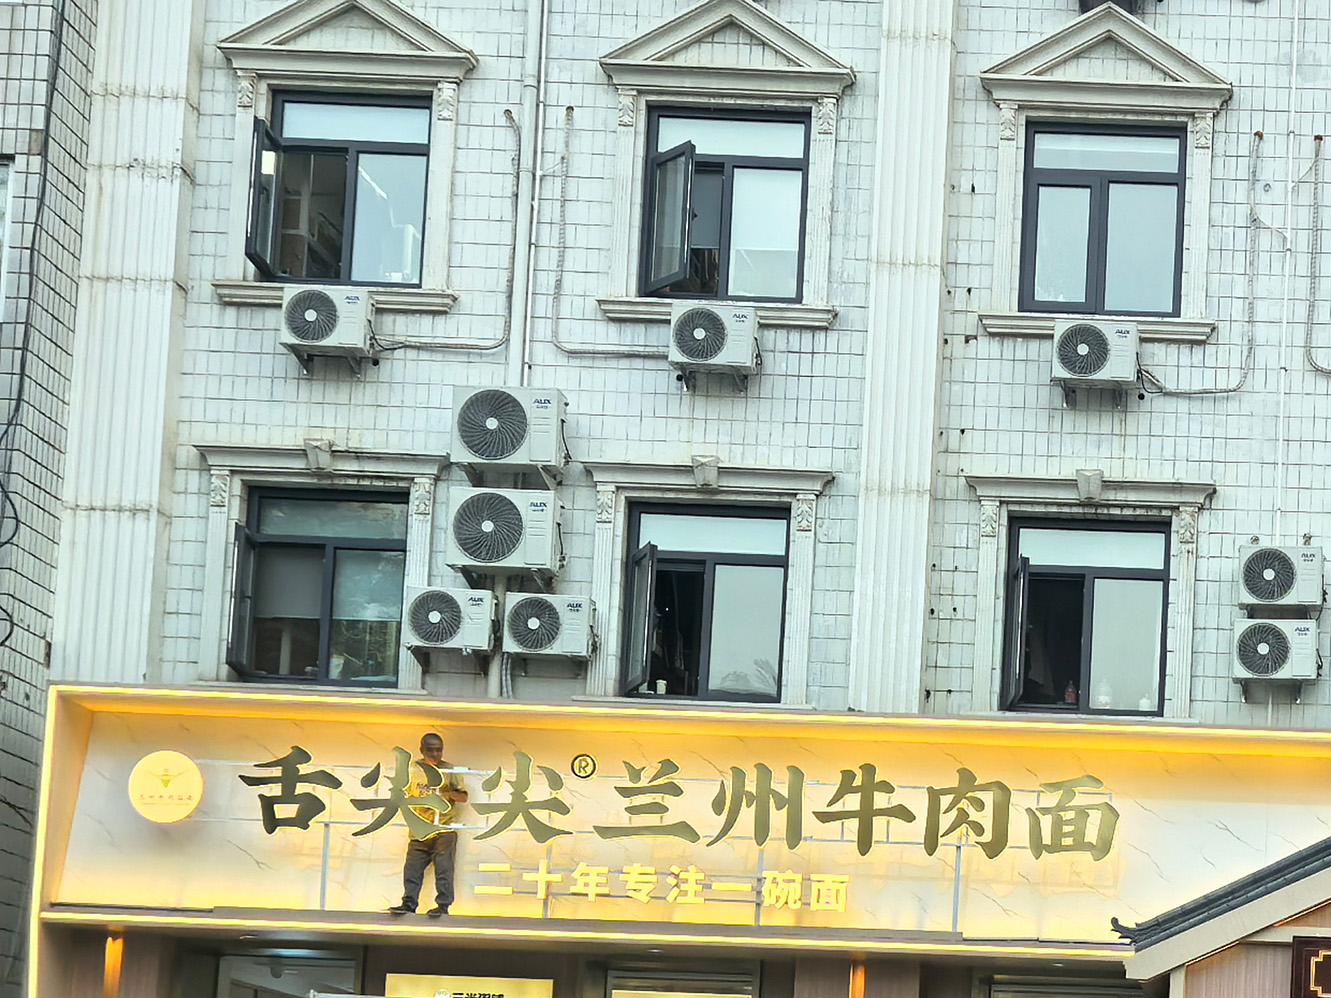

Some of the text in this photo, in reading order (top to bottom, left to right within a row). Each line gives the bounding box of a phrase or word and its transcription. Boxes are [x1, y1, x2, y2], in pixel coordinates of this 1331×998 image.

[473, 859, 851, 913] 二十年专注一碗面
